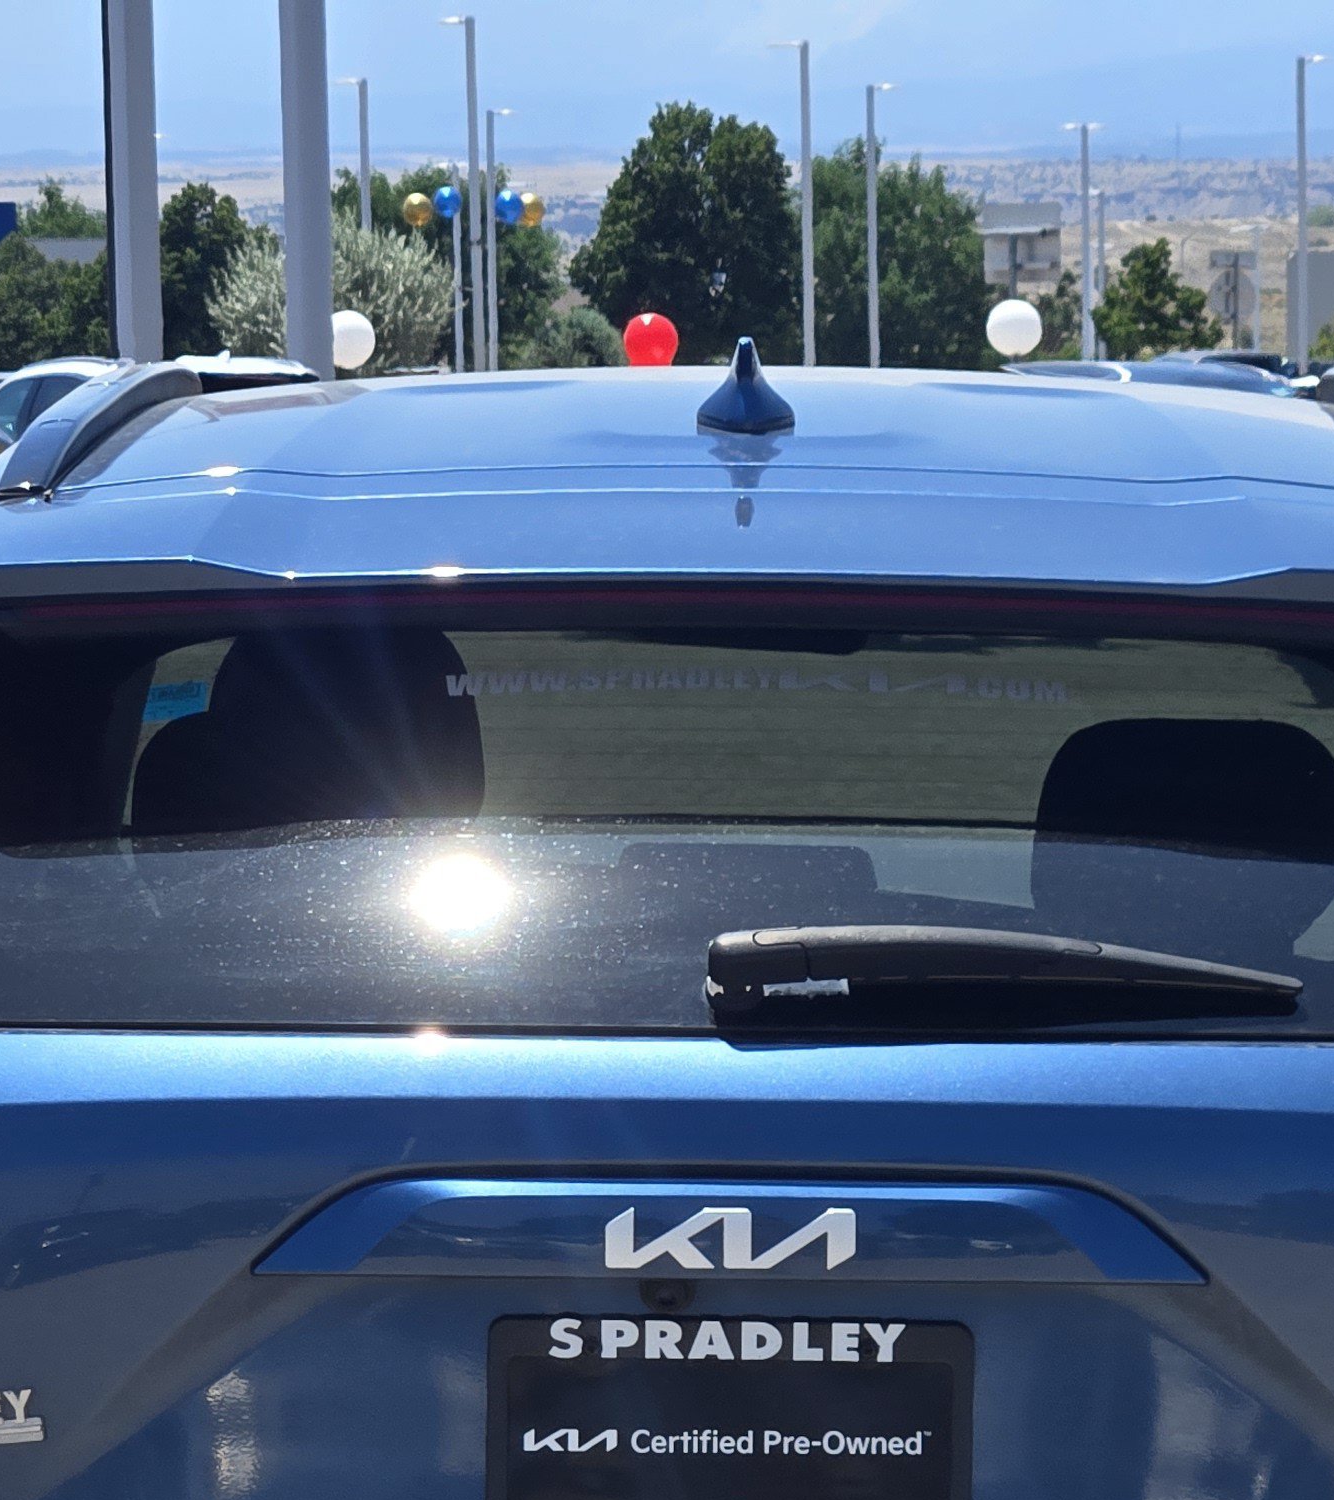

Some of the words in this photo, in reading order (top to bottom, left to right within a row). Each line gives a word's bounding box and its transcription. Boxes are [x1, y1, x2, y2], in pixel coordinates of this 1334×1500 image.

[605, 1207, 856, 1270] KIA
[549, 1318, 906, 1363] SPRADLEY
[523, 1428, 618, 1453] KIA
[631, 1429, 754, 1455] Certified
